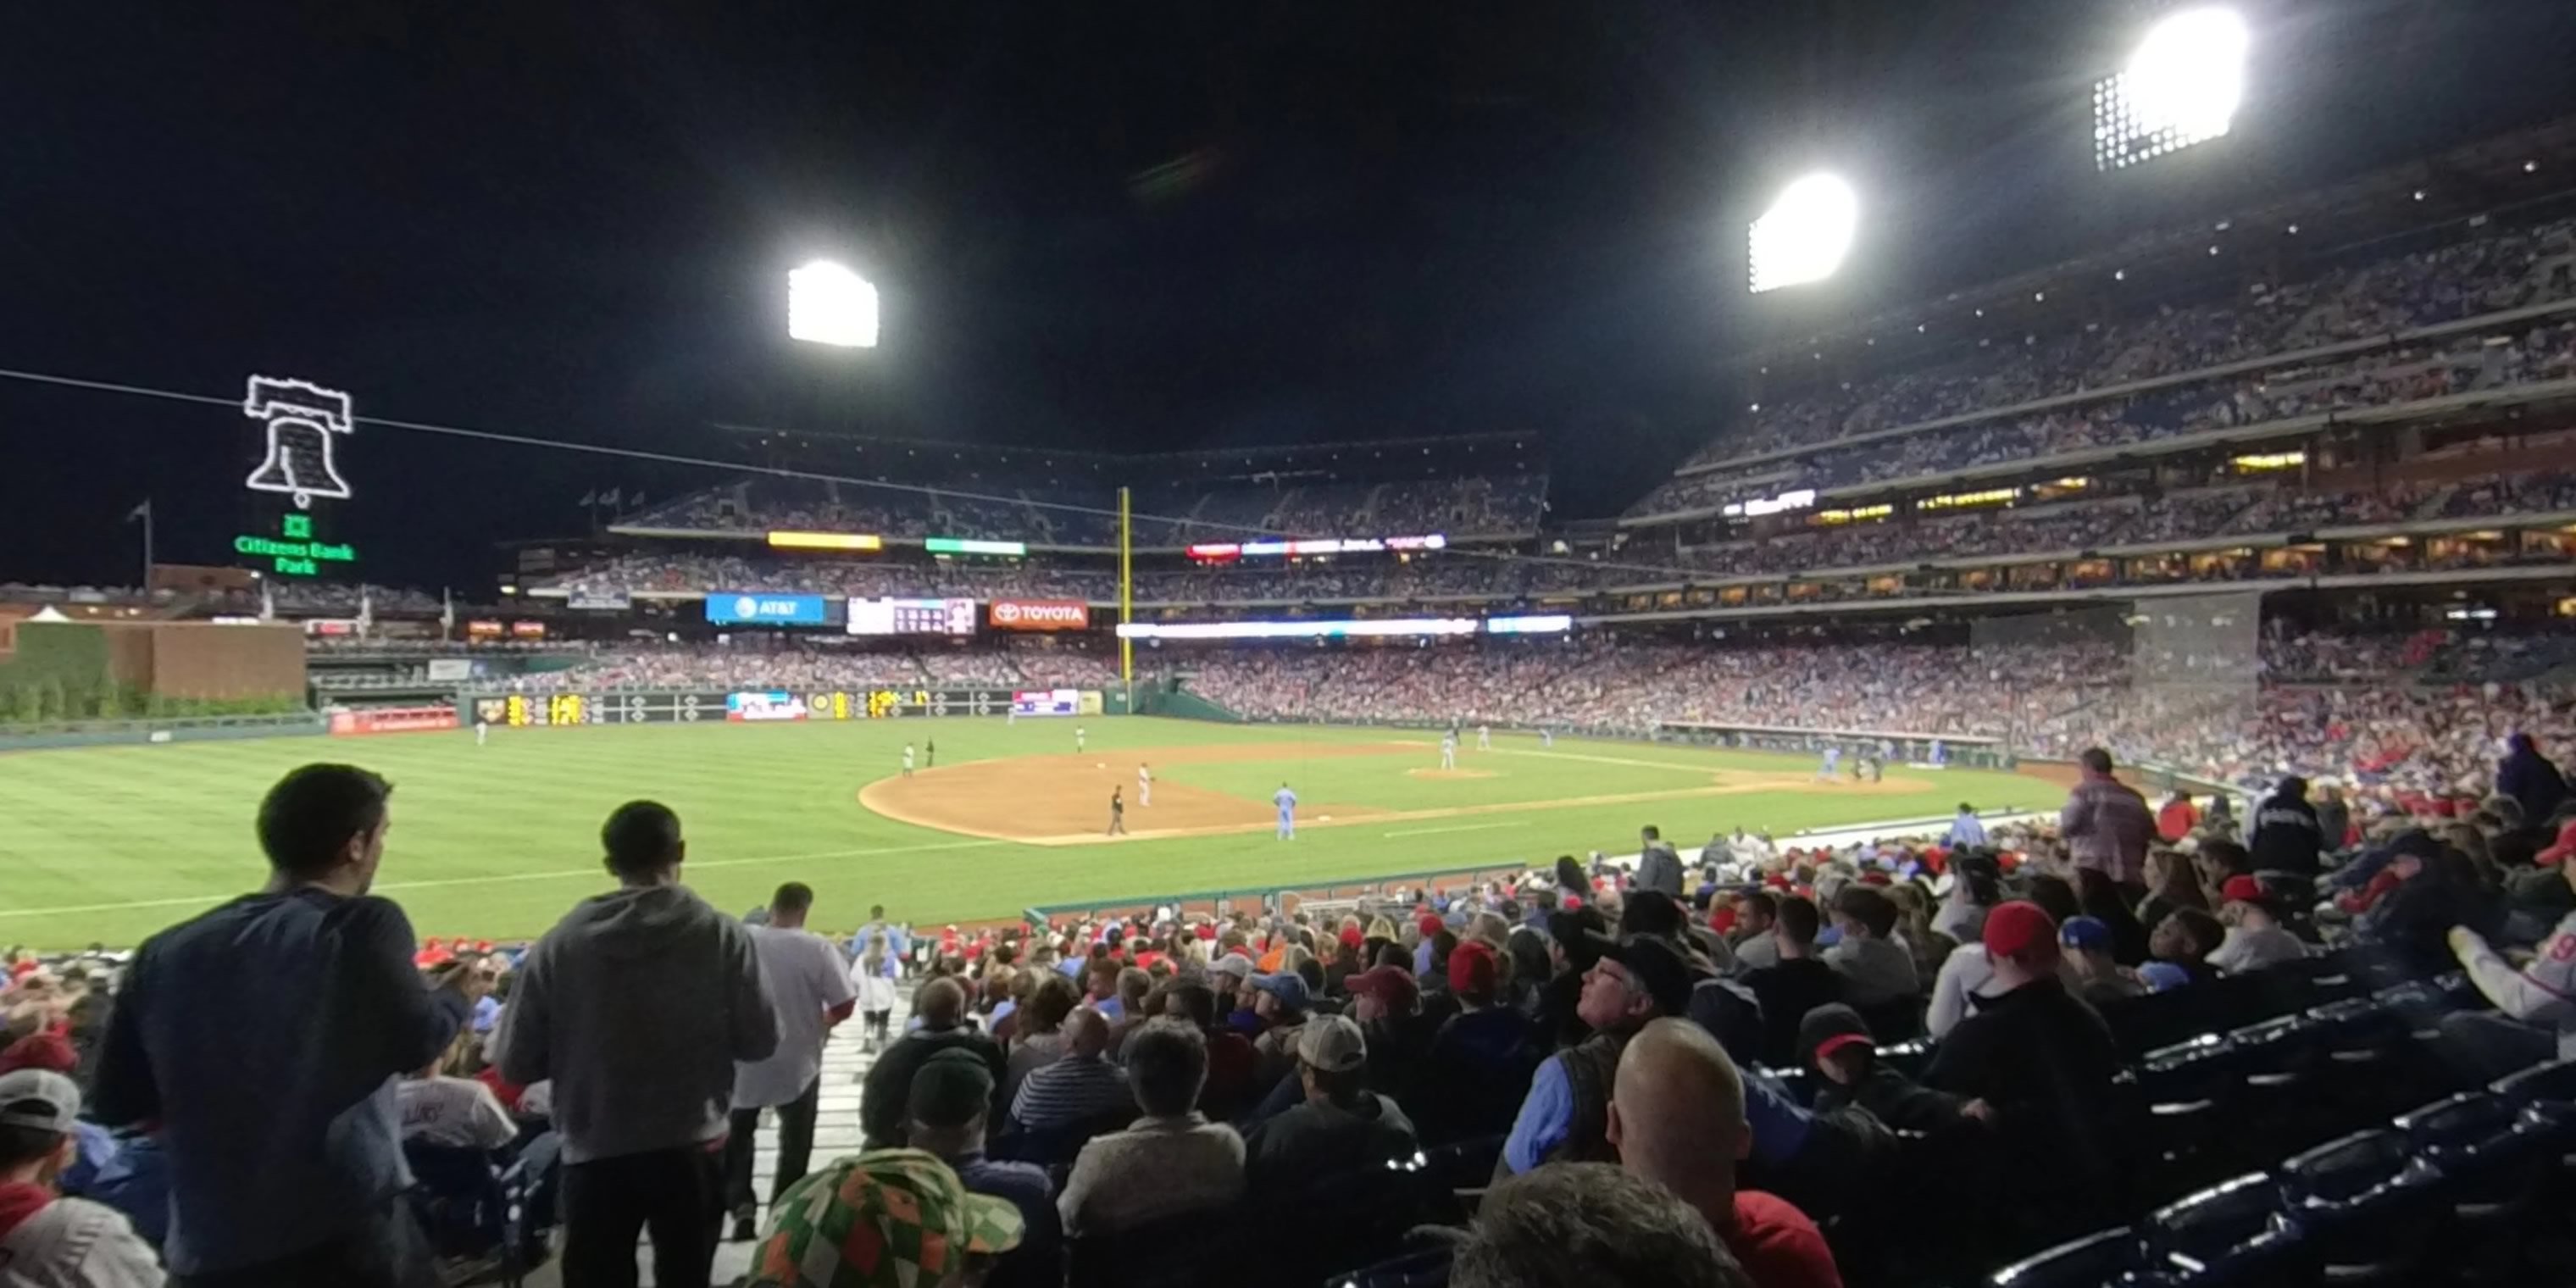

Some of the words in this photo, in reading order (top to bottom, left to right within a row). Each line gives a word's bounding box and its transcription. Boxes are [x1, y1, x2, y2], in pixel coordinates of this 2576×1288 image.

[234, 535, 308, 557] Citizens
[310, 542, 355, 561] Bank
[275, 557, 317, 575] Park
[759, 600, 797, 616] AT&T
[1020, 605, 1084, 622] TOYOTA
